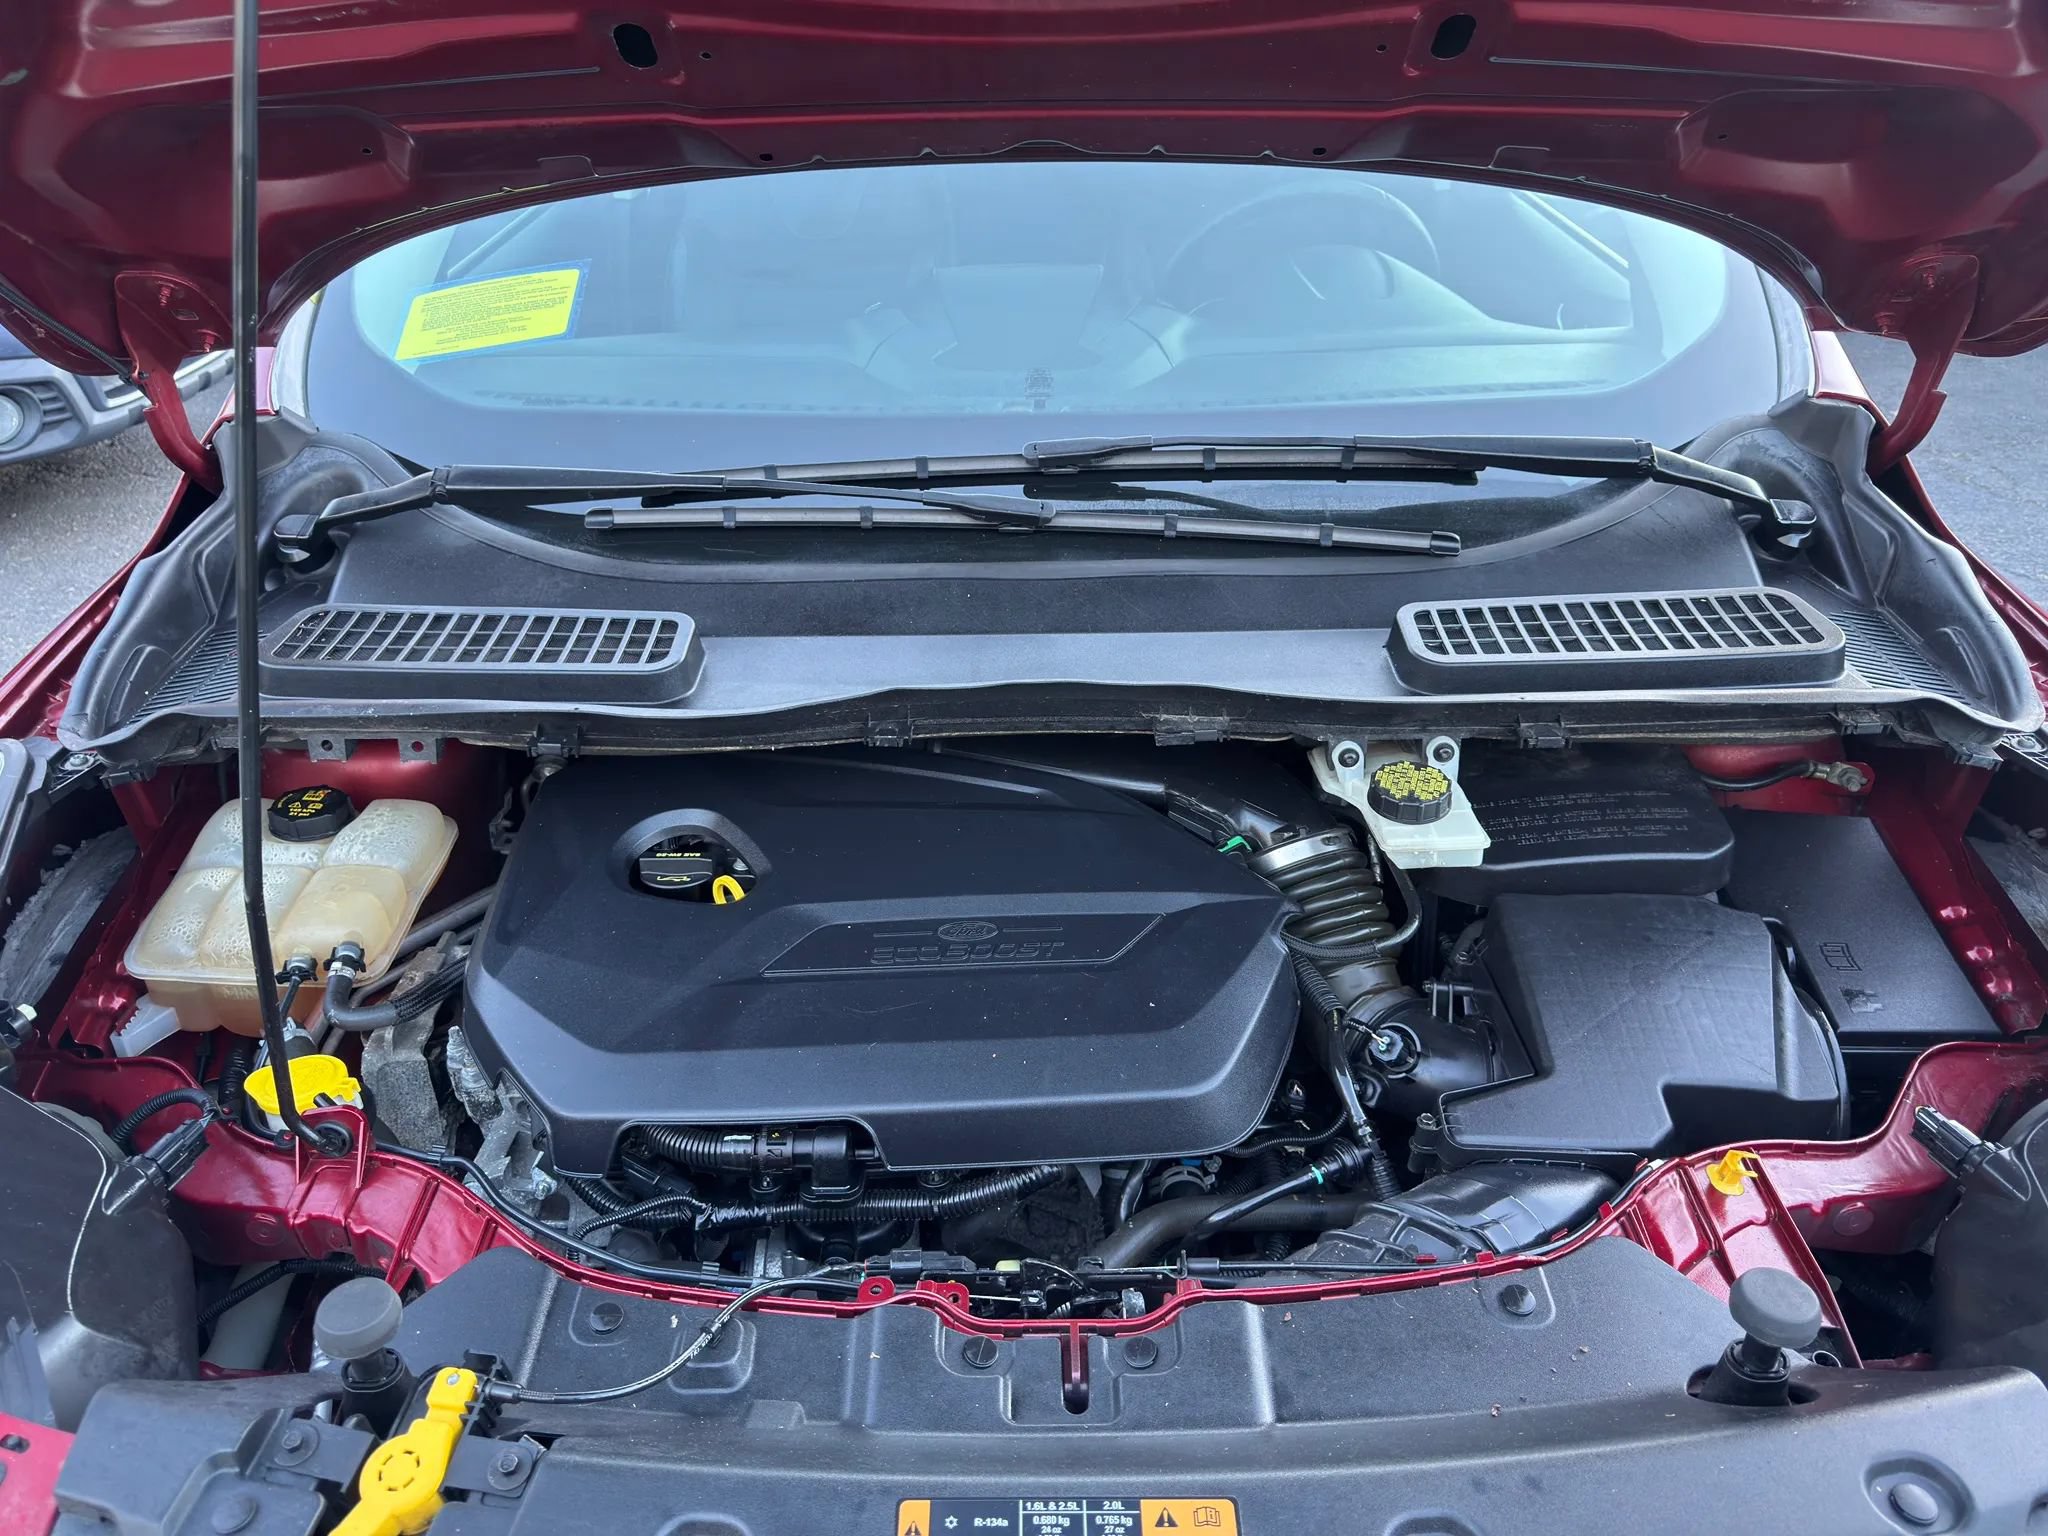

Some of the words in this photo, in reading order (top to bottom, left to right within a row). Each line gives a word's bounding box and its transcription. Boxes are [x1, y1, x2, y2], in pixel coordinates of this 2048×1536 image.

[1025, 1502, 1047, 1511] 1.6L
[1048, 1502, 1057, 1511] &
[1058, 1502, 1080, 1511] 2.5L
[1102, 1501, 1125, 1510] 2.0L
[974, 1517, 1009, 1527] R-134a
[1032, 1515, 1057, 1525] 0.680
[1058, 1515, 1070, 1527] kg
[1095, 1515, 1120, 1525] 0.765
[1121, 1515, 1133, 1527] kg
[1104, 1526, 1114, 1534] 27
